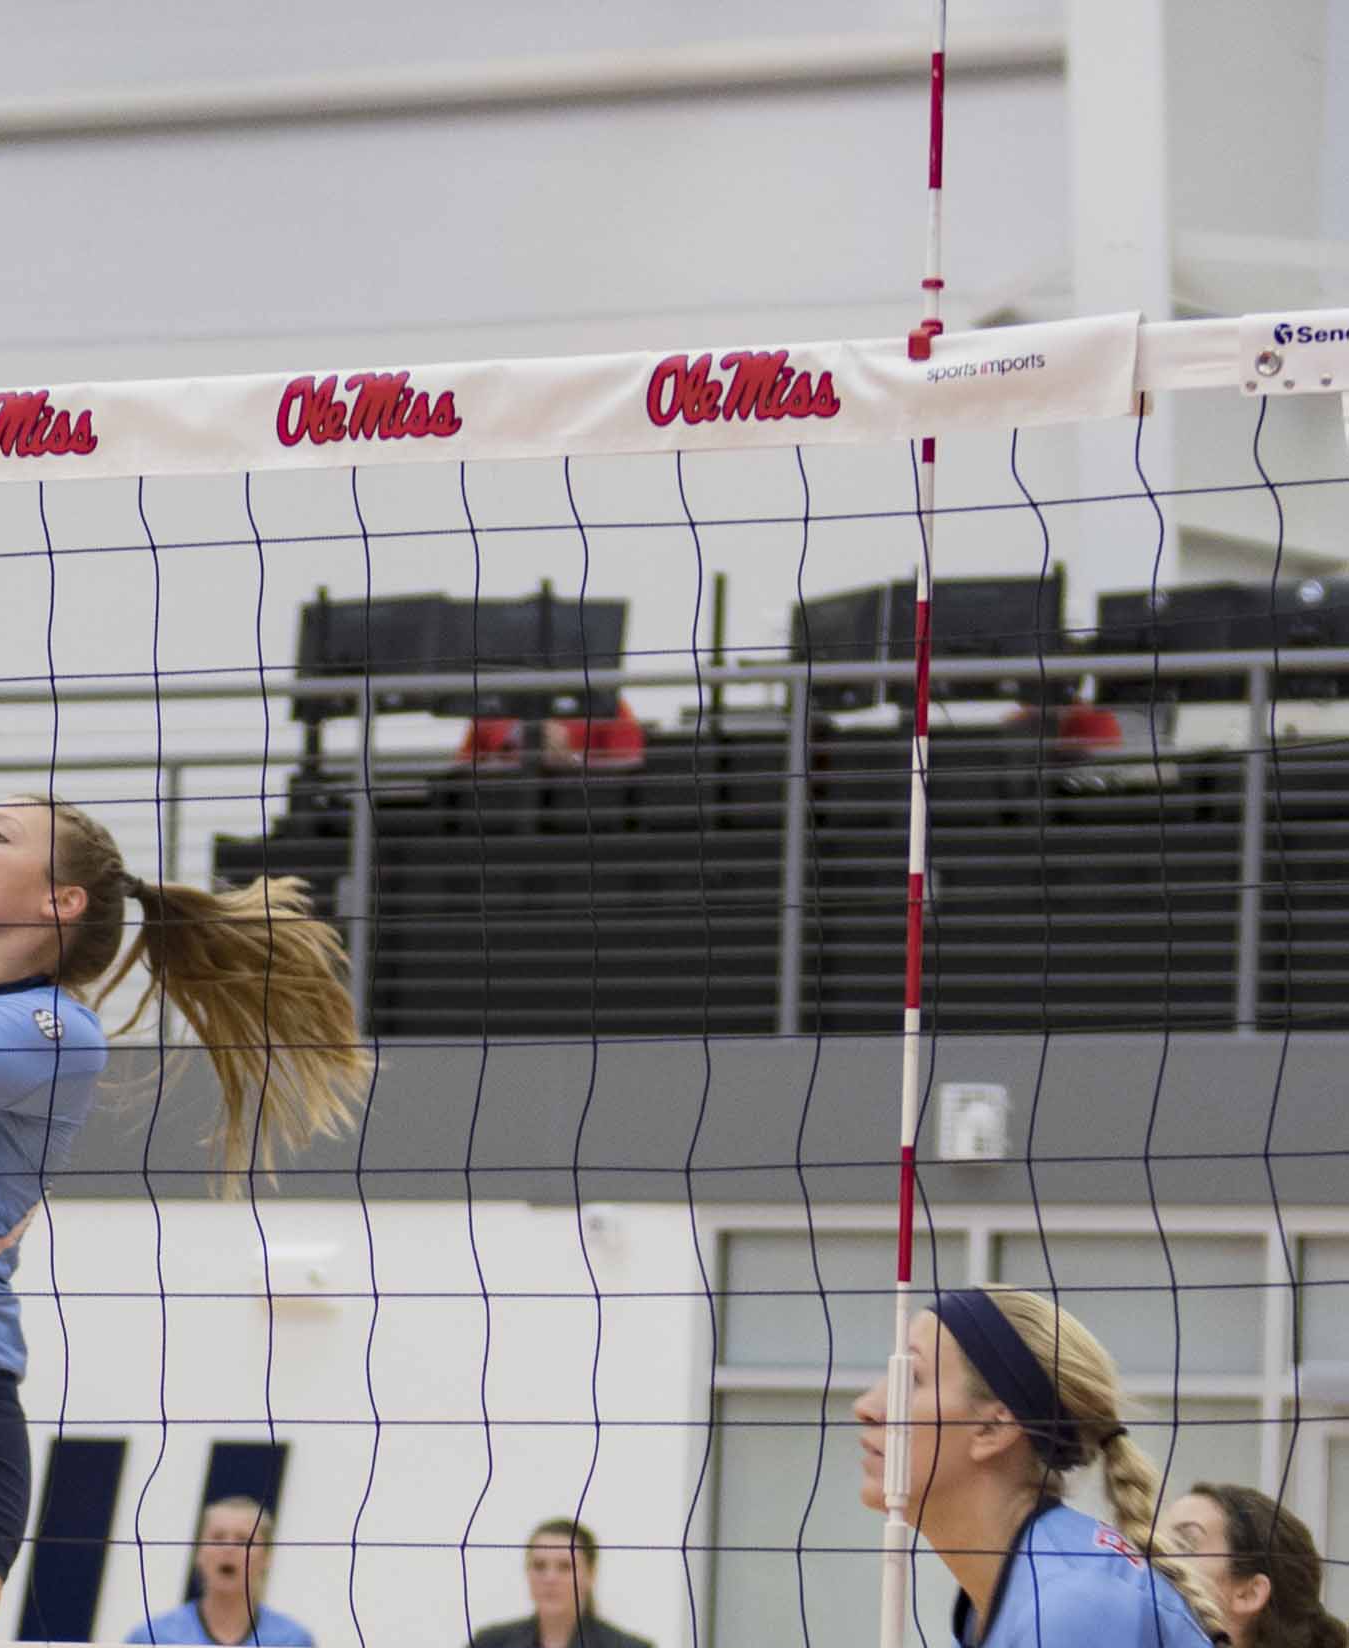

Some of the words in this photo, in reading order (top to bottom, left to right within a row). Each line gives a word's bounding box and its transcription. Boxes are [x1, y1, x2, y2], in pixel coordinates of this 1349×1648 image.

[647, 353, 720, 427] Ole
[720, 351, 840, 421] Miss
[927, 362, 978, 383] sports
[980, 354, 1045, 376] imports
[277, 372, 347, 448] Ole
[347, 370, 462, 442] Miss
